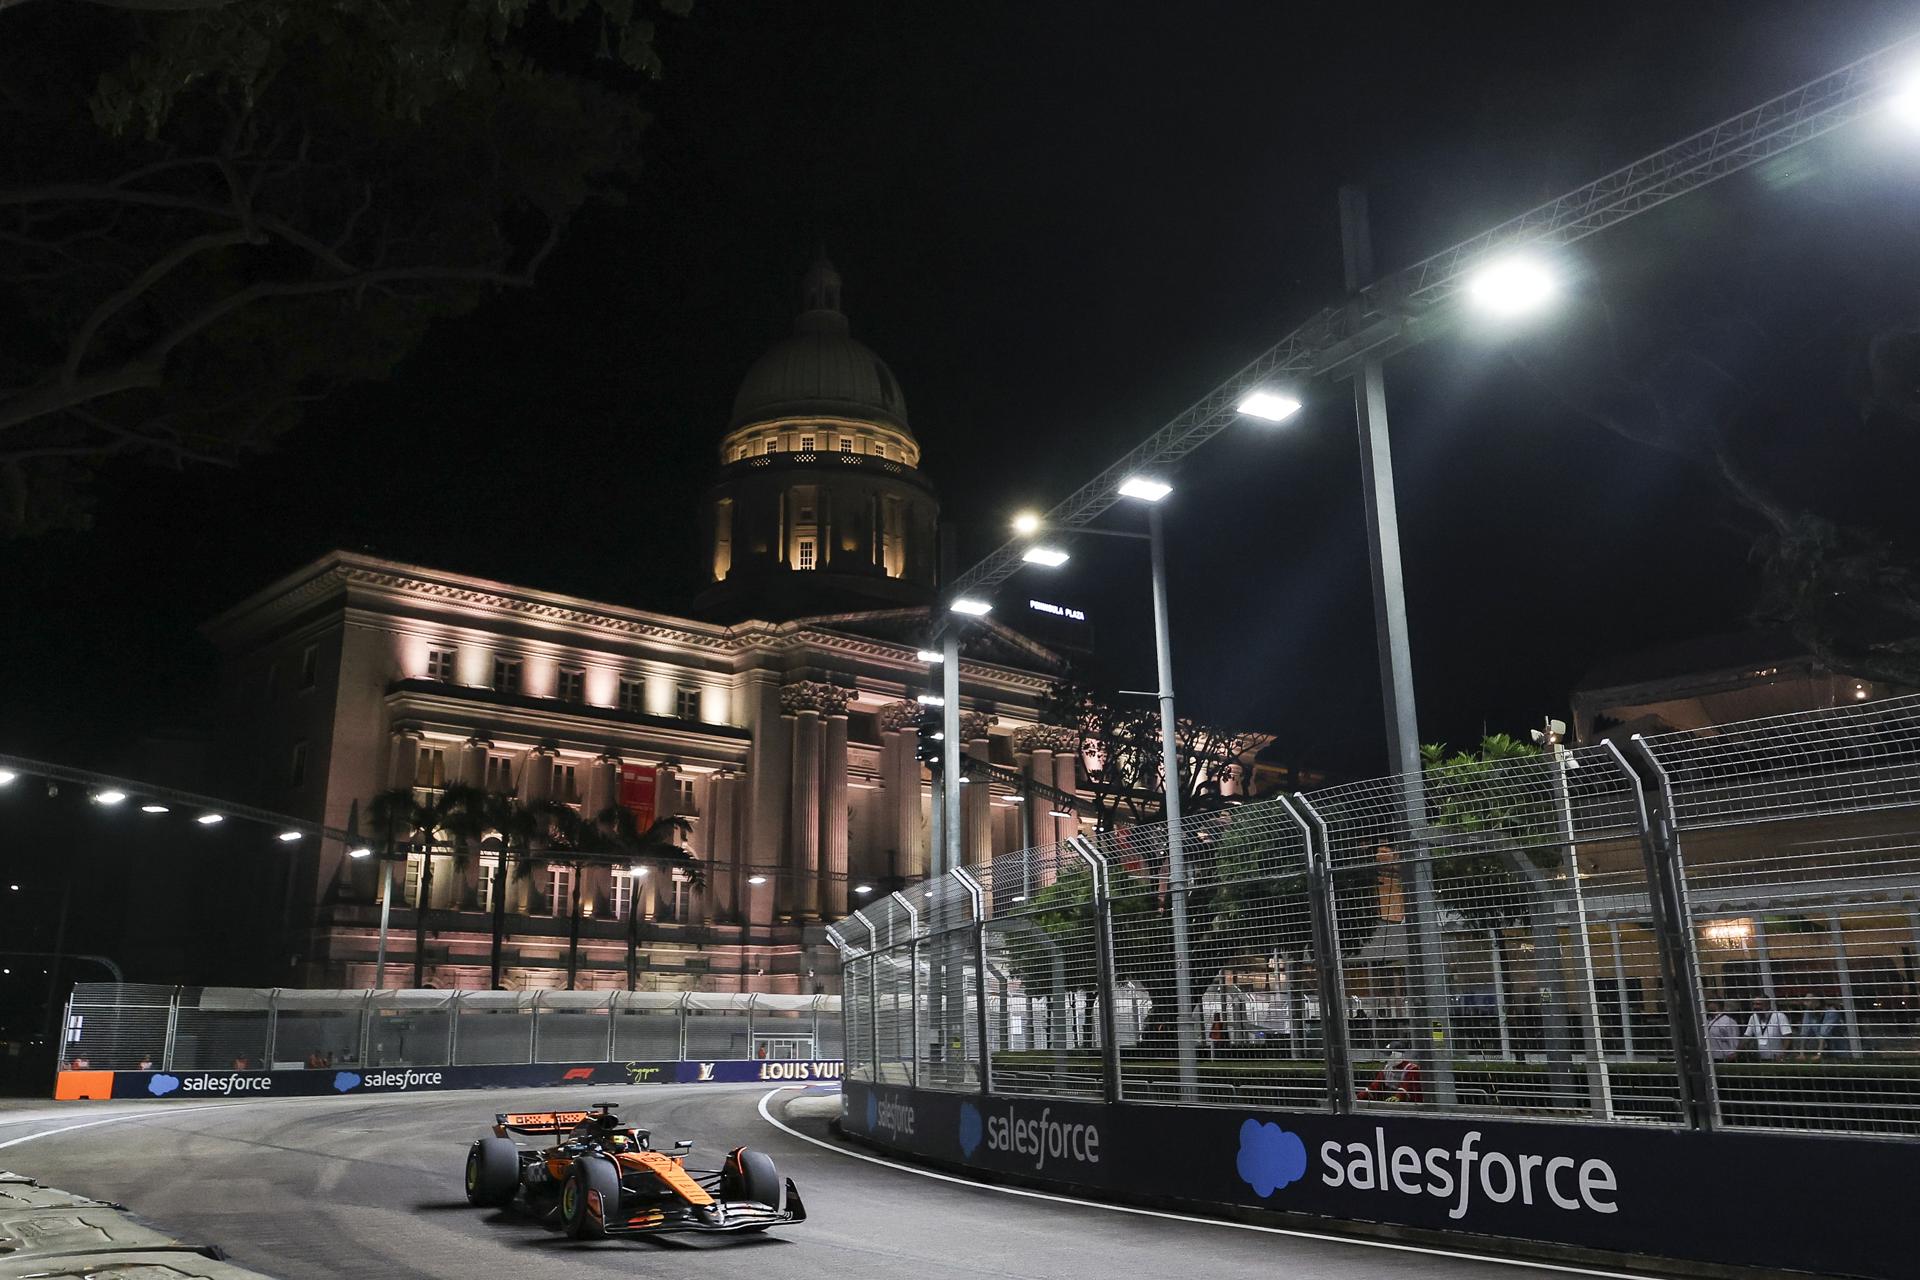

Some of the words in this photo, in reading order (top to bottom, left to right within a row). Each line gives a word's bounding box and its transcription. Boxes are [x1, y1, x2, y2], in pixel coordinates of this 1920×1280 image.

[1065, 608, 1084, 620] PLAZA
[365, 1069, 442, 1090] salesforce
[761, 1062, 809, 1080] LOUIS
[183, 1073, 272, 1095] salesforce
[878, 1094, 915, 1141] salesforce
[988, 1105, 1099, 1170] salesforce
[1321, 1127, 1619, 1220] salesforce
